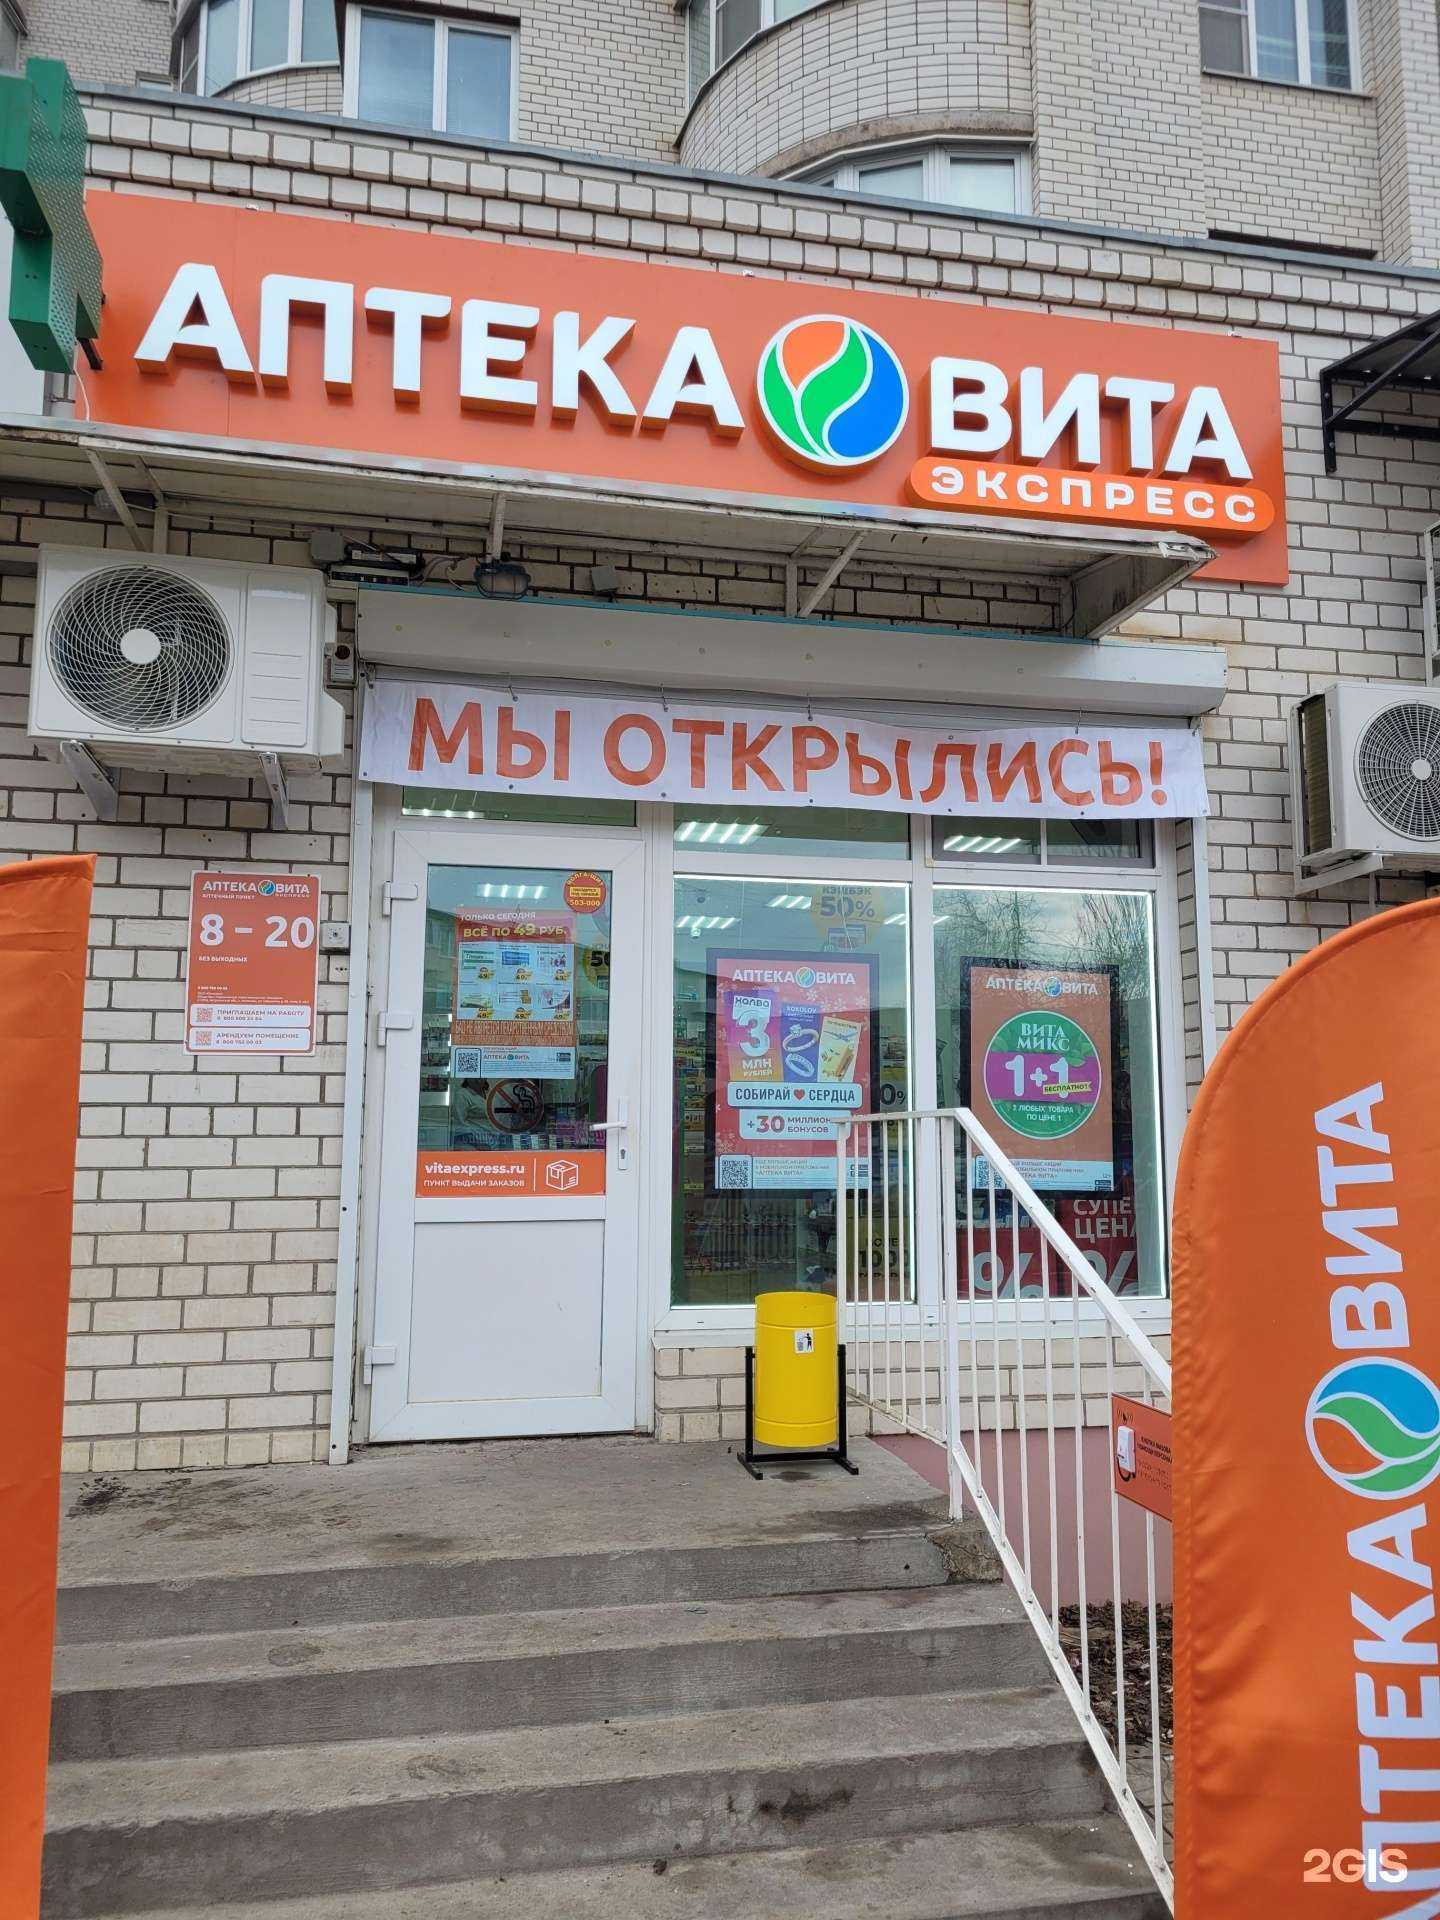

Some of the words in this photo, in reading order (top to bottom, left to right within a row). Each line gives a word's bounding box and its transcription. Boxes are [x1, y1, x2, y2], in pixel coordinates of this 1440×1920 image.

[134, 263, 746, 434] АПТЕКА
[929, 356, 1254, 481] ВИТА
[931, 465, 1256, 523] ЭКСПРЕСС
[407, 697, 572, 782] МЫ
[603, 713, 1166, 807] ОТКРЫЛИСЬ!
[202, 880, 258, 893] АПТЕКА
[275, 883, 310, 894] ВИТА
[821, 896, 875, 918] 50%
[496, 911, 536, 921] СЕГОДНЯ
[199, 913, 225, 947] 8
[264, 915, 316, 950] 20
[463, 925, 488, 938] ВСЁ
[491, 927, 510, 937] ПО
[513, 923, 536, 936] 49
[539, 925, 568, 936] РУБ.
[198, 955, 211, 963] БЕЗ
[211, 955, 249, 963] ВЫХОДНЫХ
[732, 969, 795, 984] АПТЕКА
[815, 971, 857, 985] ВИТА
[985, 976, 1045, 991] АПТЕКА
[1062, 981, 1098, 996] ВИТА
[216, 1032, 254, 1040] АРЕНДУЕМ
[738, 1010, 771, 1057] 3
[1021, 1023, 1067, 1038] ВИТА
[1016, 1036, 1070, 1051] МИКС
[742, 1058, 773, 1070] МЛН
[1005, 1054, 1069, 1099] 1+1
[735, 1087, 791, 1101] СОБИРАЙ
[808, 1089, 856, 1103] СЕРДЦА
[1018, 1104, 1046, 1113] ЛЮБЫХ
[1048, 1105, 1074, 1113] ТОВАРА
[1026, 1113, 1037, 1121] ПО
[1038, 1114, 1057, 1122] ЦЕНЕ
[424, 1161, 525, 1177] vitaexpress.ru
[423, 1179, 449, 1188] ПУНКТ
[451, 1179, 487, 1188] ВЫДАЧИ
[488, 1179, 525, 1188] ЗАКАЗОВ
[1073, 1198, 1136, 1216] СУПЕ
[1314, 1080, 1410, 1350] ВИТА
[1346, 1503, 1440, 1920] ПТЕКА
